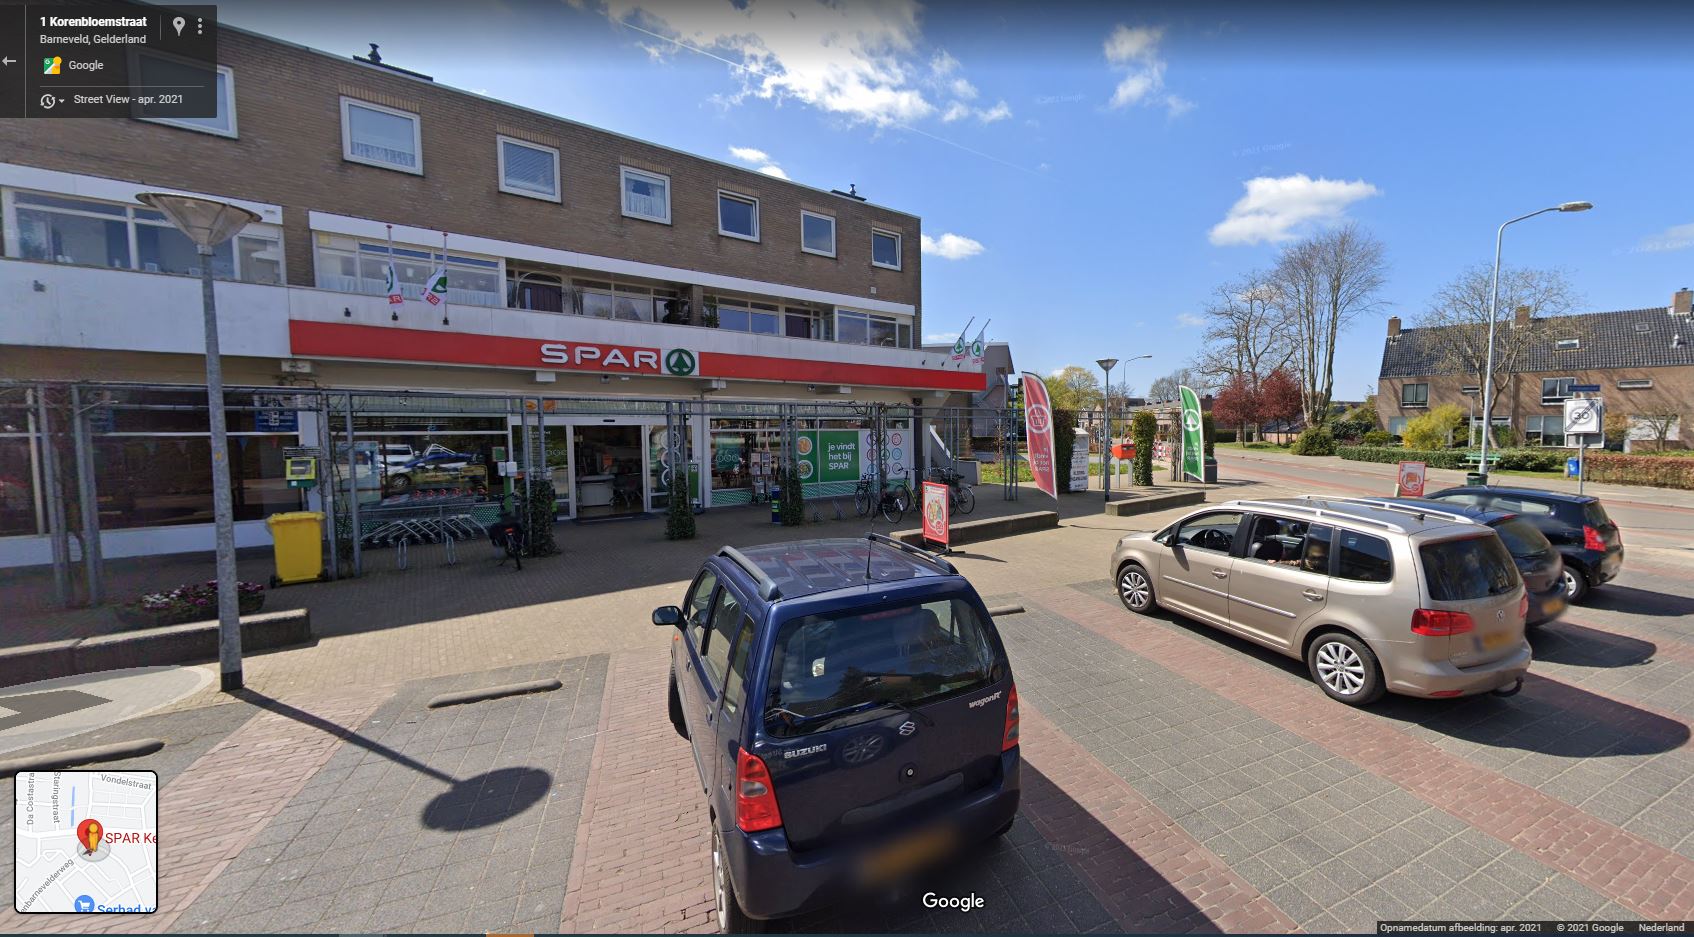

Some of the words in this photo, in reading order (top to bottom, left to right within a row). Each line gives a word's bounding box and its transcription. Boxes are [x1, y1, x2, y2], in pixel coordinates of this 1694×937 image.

[541, 343, 658, 369] SPAR
[1574, 412, 1589, 421] 30
[828, 443, 835, 452] je
[837, 442, 855, 450] vindt
[829, 452, 841, 460] het
[843, 452, 851, 462] bij
[829, 462, 849, 470] SPAR
[784, 743, 827, 759] SUZUKI
